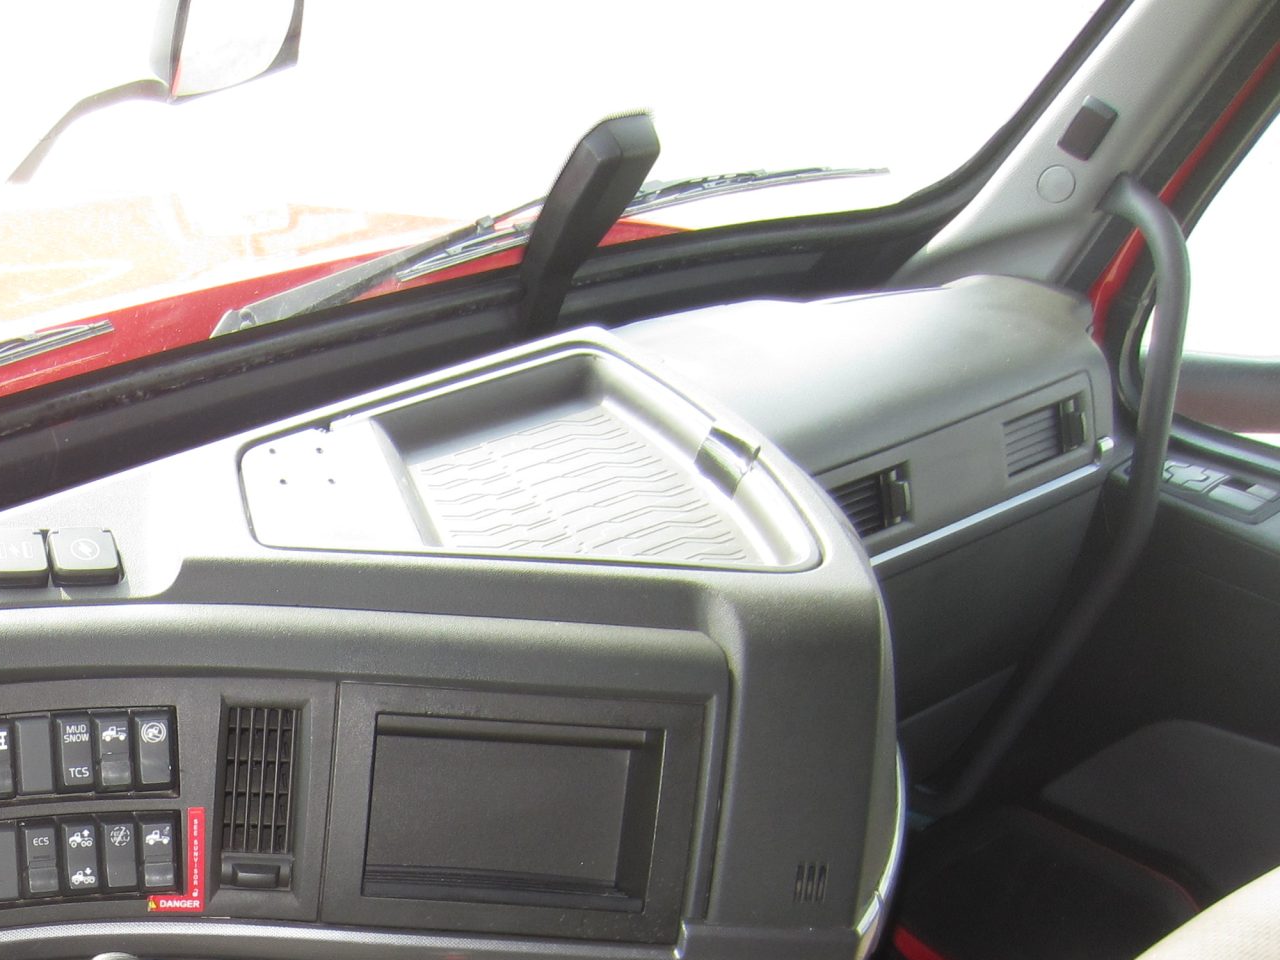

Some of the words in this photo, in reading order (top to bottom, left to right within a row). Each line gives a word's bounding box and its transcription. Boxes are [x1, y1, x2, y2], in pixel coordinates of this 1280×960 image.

[66, 724, 87, 734] MUD
[63, 733, 90, 743] SNOW
[69, 767, 90, 778] TCS
[33, 836, 50, 846] ECS
[159, 898, 200, 909] DANGER
